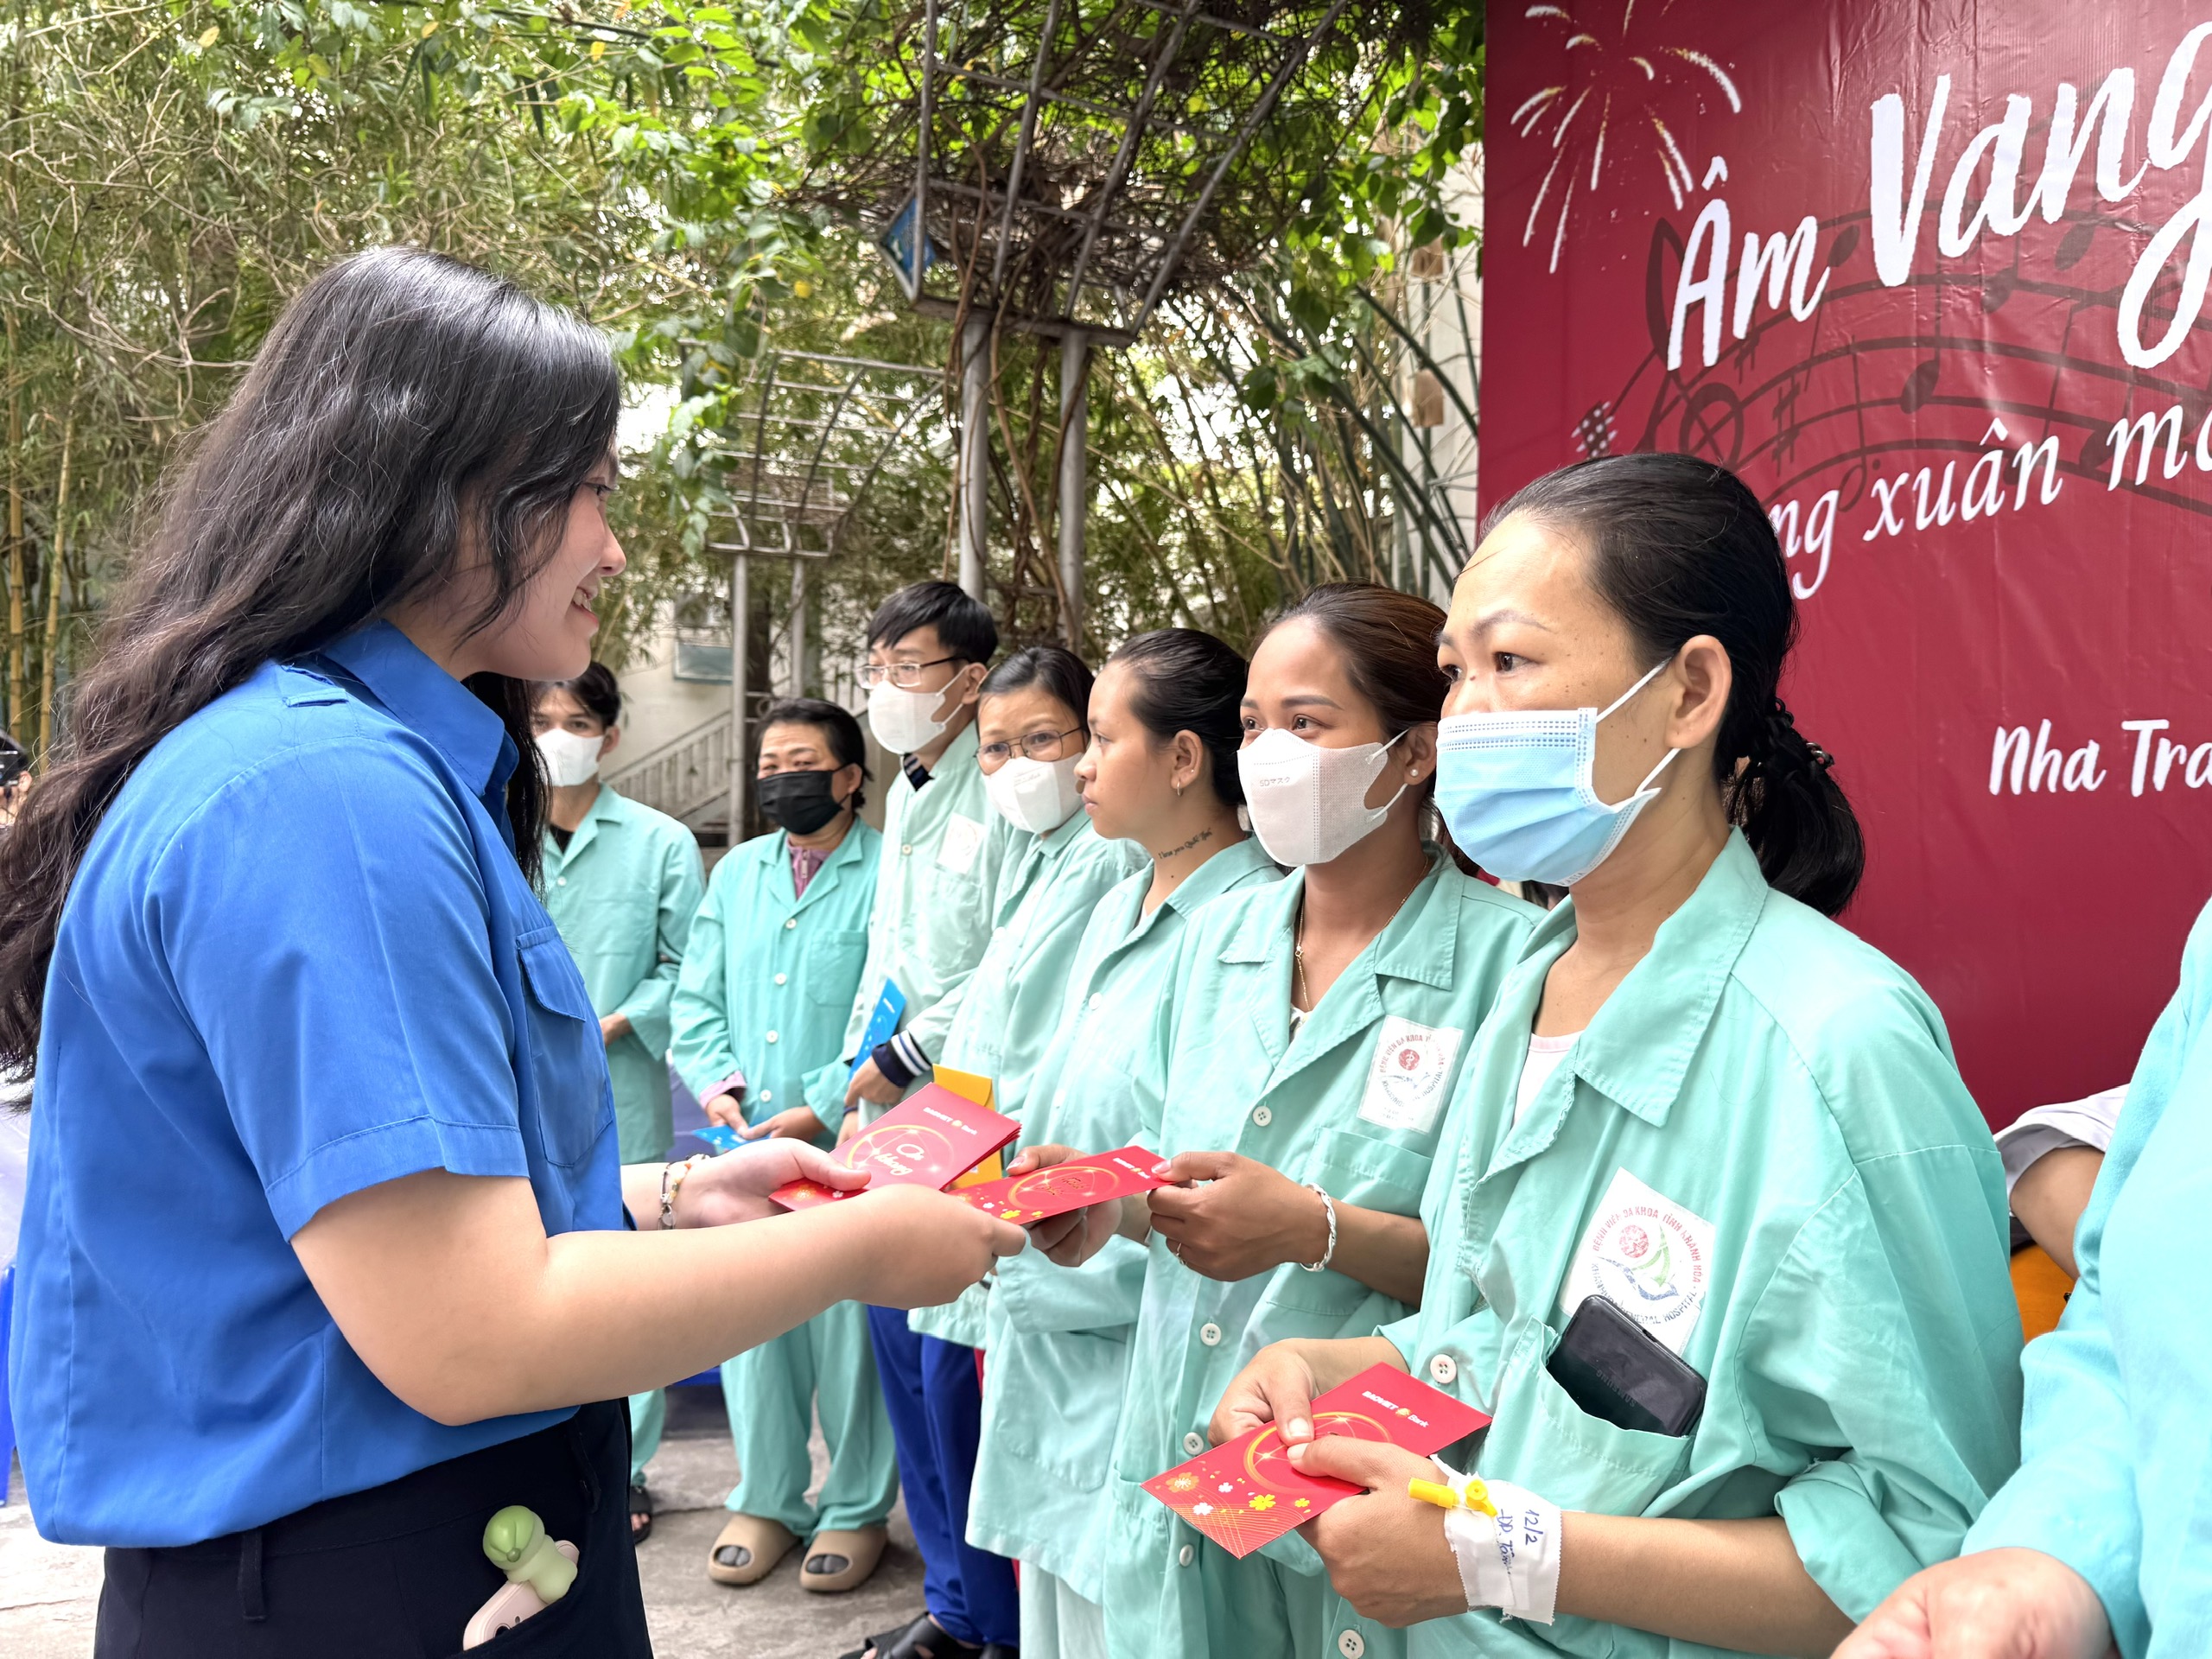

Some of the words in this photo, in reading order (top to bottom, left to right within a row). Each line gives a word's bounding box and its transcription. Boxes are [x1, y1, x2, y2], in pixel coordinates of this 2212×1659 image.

[1667, 156, 1830, 372] Âm
[1871, 21, 2212, 370] Vang
[1769, 489, 1840, 600] ng
[1862, 417, 2063, 542] xuân
[1989, 718, 2107, 796] Nha
[1408, 1414, 1429, 1428] Bank
[1523, 1509, 1544, 1546] 12/2
